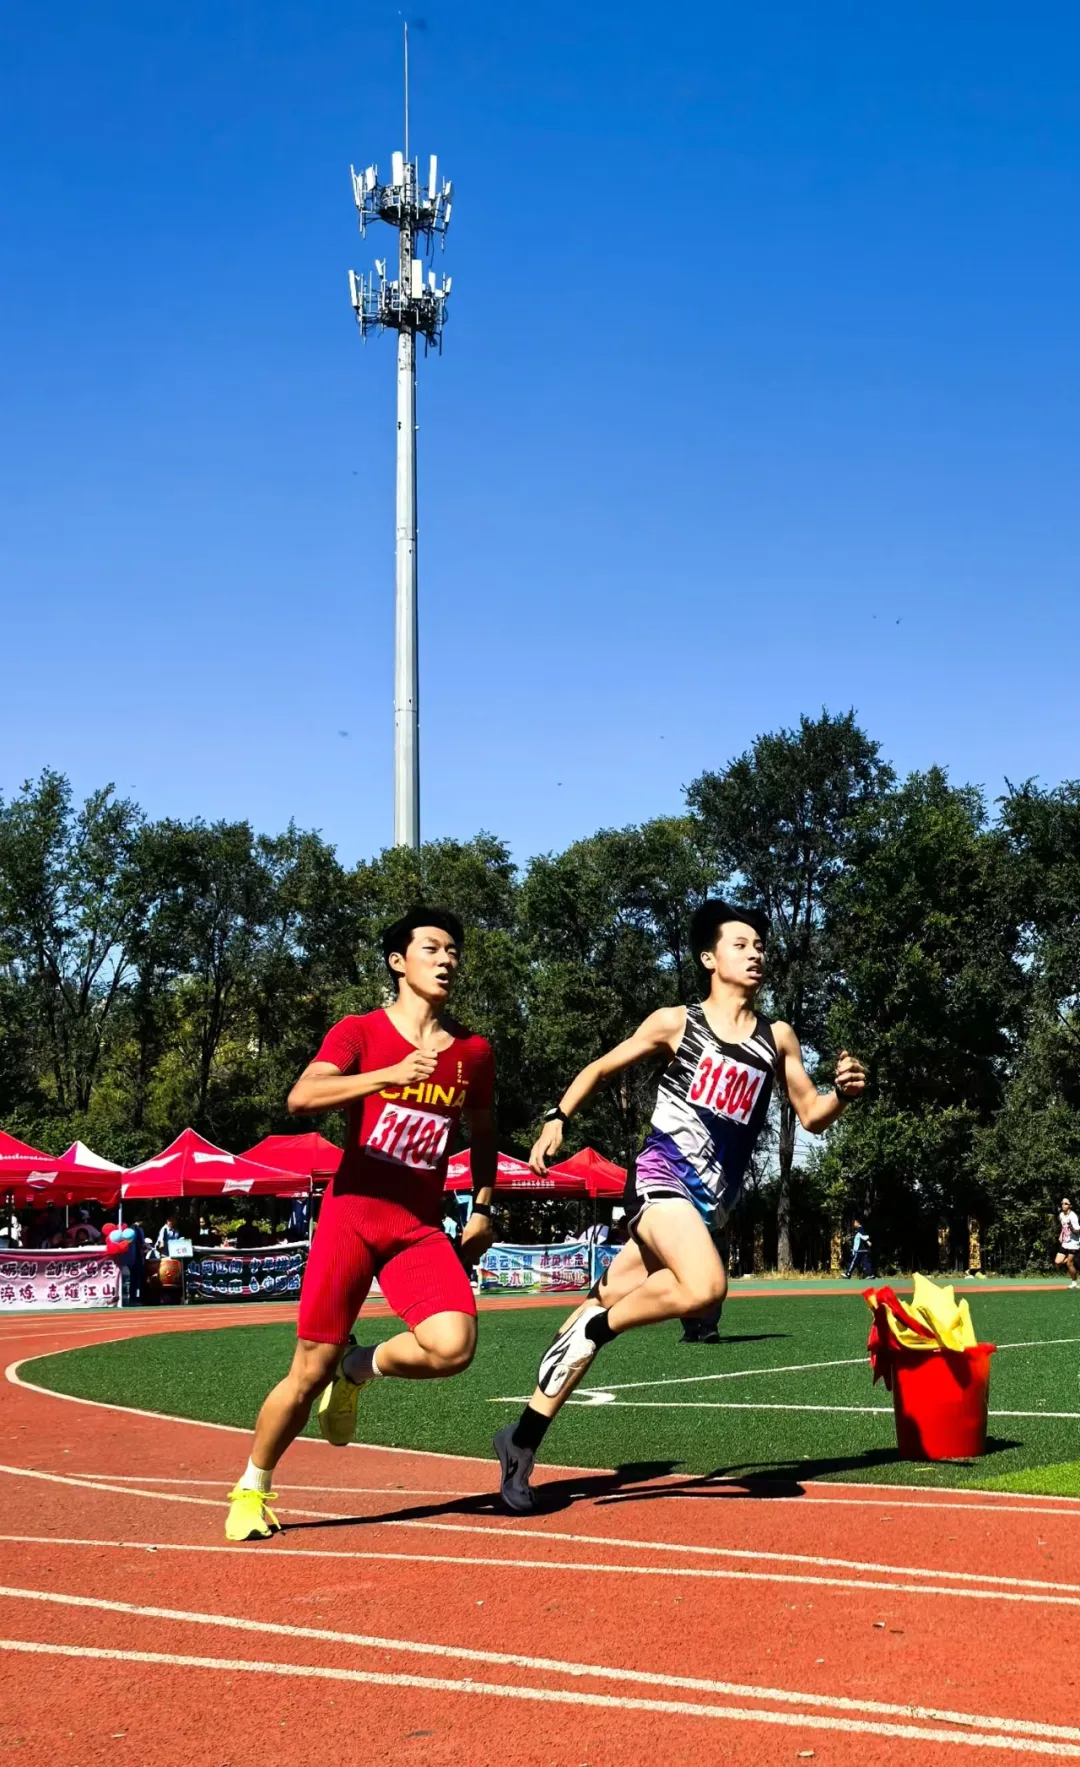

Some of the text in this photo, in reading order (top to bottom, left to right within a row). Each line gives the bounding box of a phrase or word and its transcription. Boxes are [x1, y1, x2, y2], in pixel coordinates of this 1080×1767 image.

[691, 1056, 760, 1120] 31304
[44, 1260, 117, 1278] 剑指长天
[46, 1283, 117, 1301] 志耀江山
